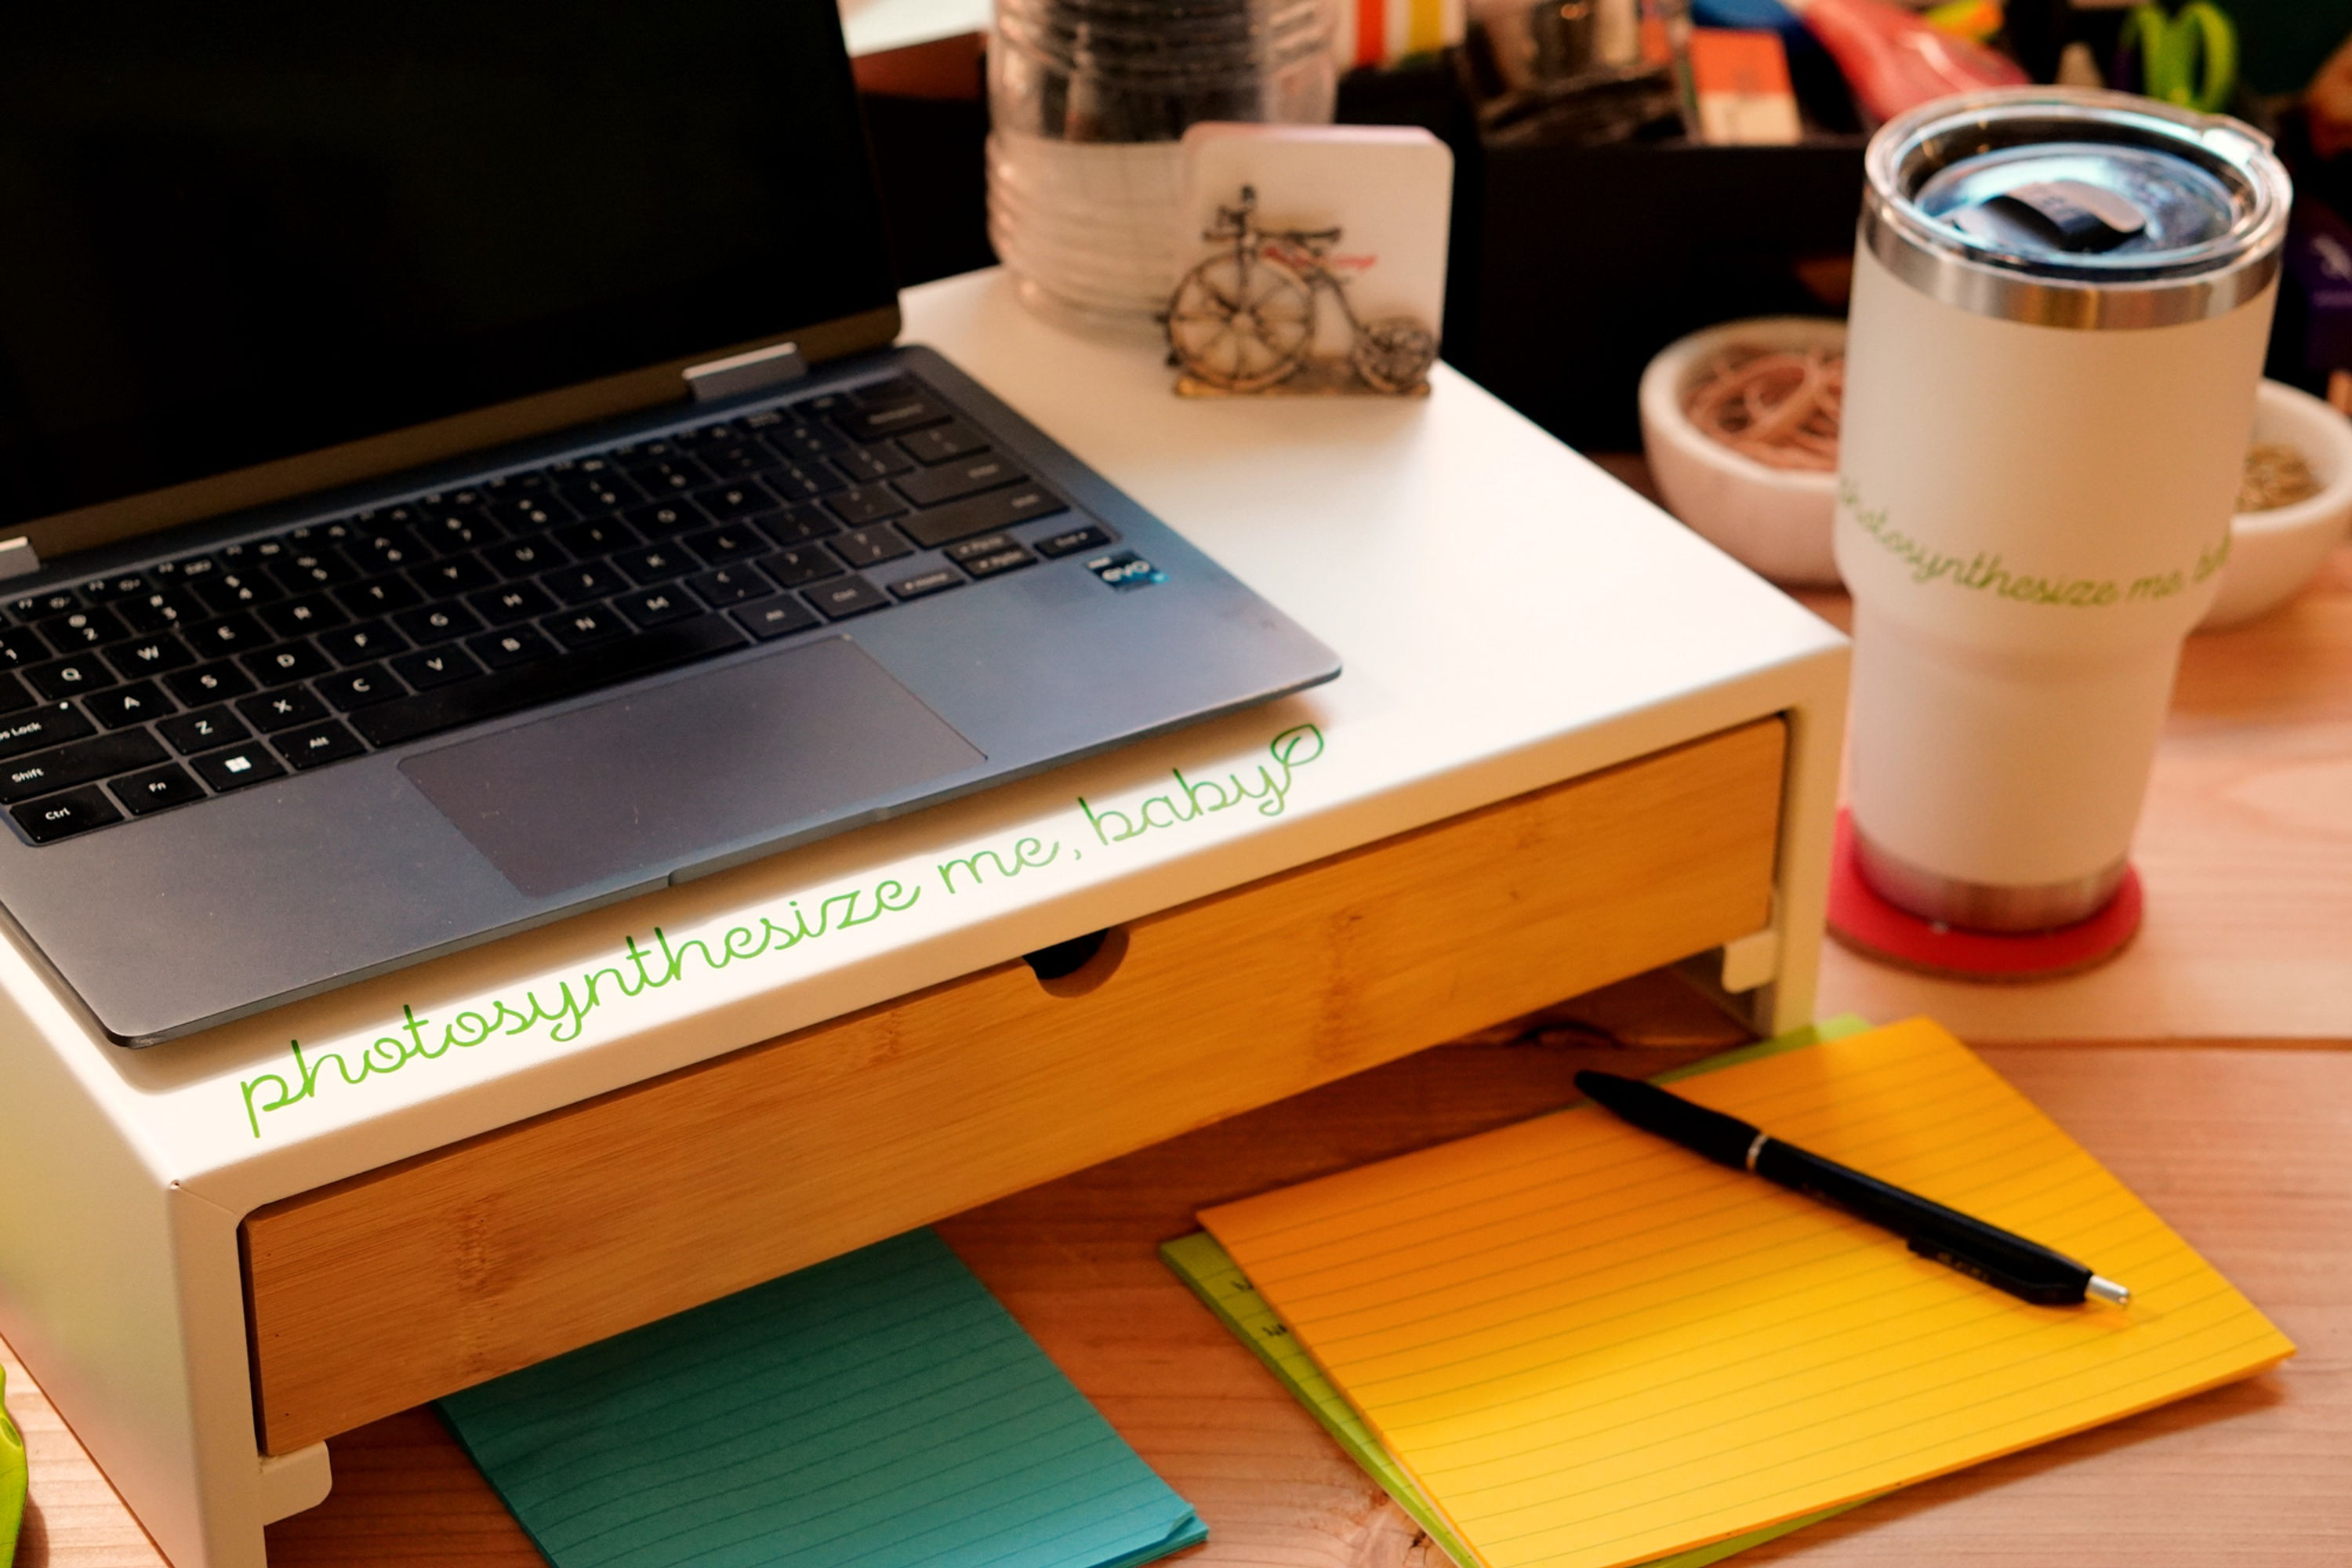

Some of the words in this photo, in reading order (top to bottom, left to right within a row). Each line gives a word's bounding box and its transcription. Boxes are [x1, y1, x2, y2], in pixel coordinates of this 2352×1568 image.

[1840, 478, 2122, 607] hotosynthesize
[137, 645, 159, 661] W
[61, 668, 82, 681] Q
[353, 678, 370, 691] C
[124, 696, 140, 710] A
[273, 699, 292, 713] X
[195, 720, 213, 735] Z
[11, 768, 44, 783] Shift
[45, 807, 71, 821] Ctrl
[239, 878, 922, 1140] photosynthesize
[936, 836, 1083, 895] me,
[1076, 733, 1312, 847] baby
